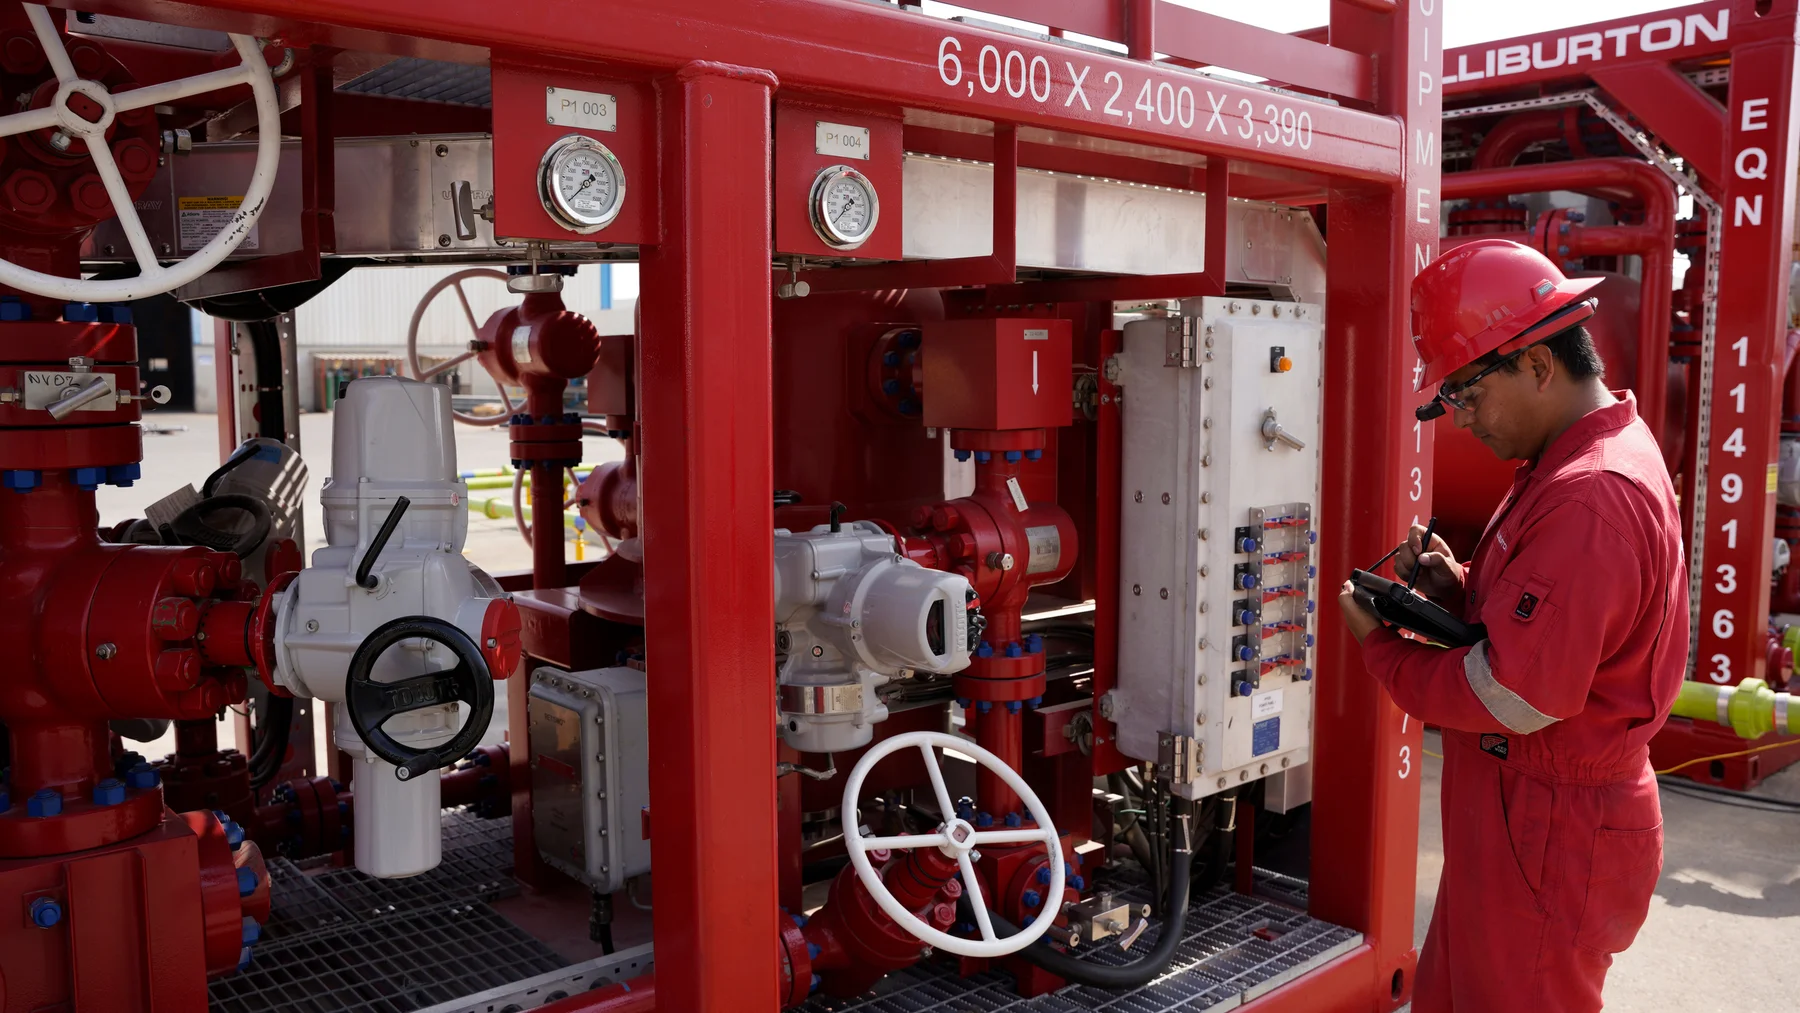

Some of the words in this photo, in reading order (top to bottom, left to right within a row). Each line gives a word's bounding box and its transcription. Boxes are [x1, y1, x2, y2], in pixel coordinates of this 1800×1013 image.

[937, 36, 1052, 103] 6,000
[1064, 61, 1092, 112] X
[1103, 70, 1196, 130] 2,400
[1205, 90, 1229, 137] X
[1237, 97, 1313, 151] 3,390
[1442, 9, 1730, 85] LIBURTON
[582, 102, 607, 117] 003
[842, 135, 862, 148] 004
[1734, 97, 1770, 228] EQN
[1709, 336, 1749, 684] 11491363
